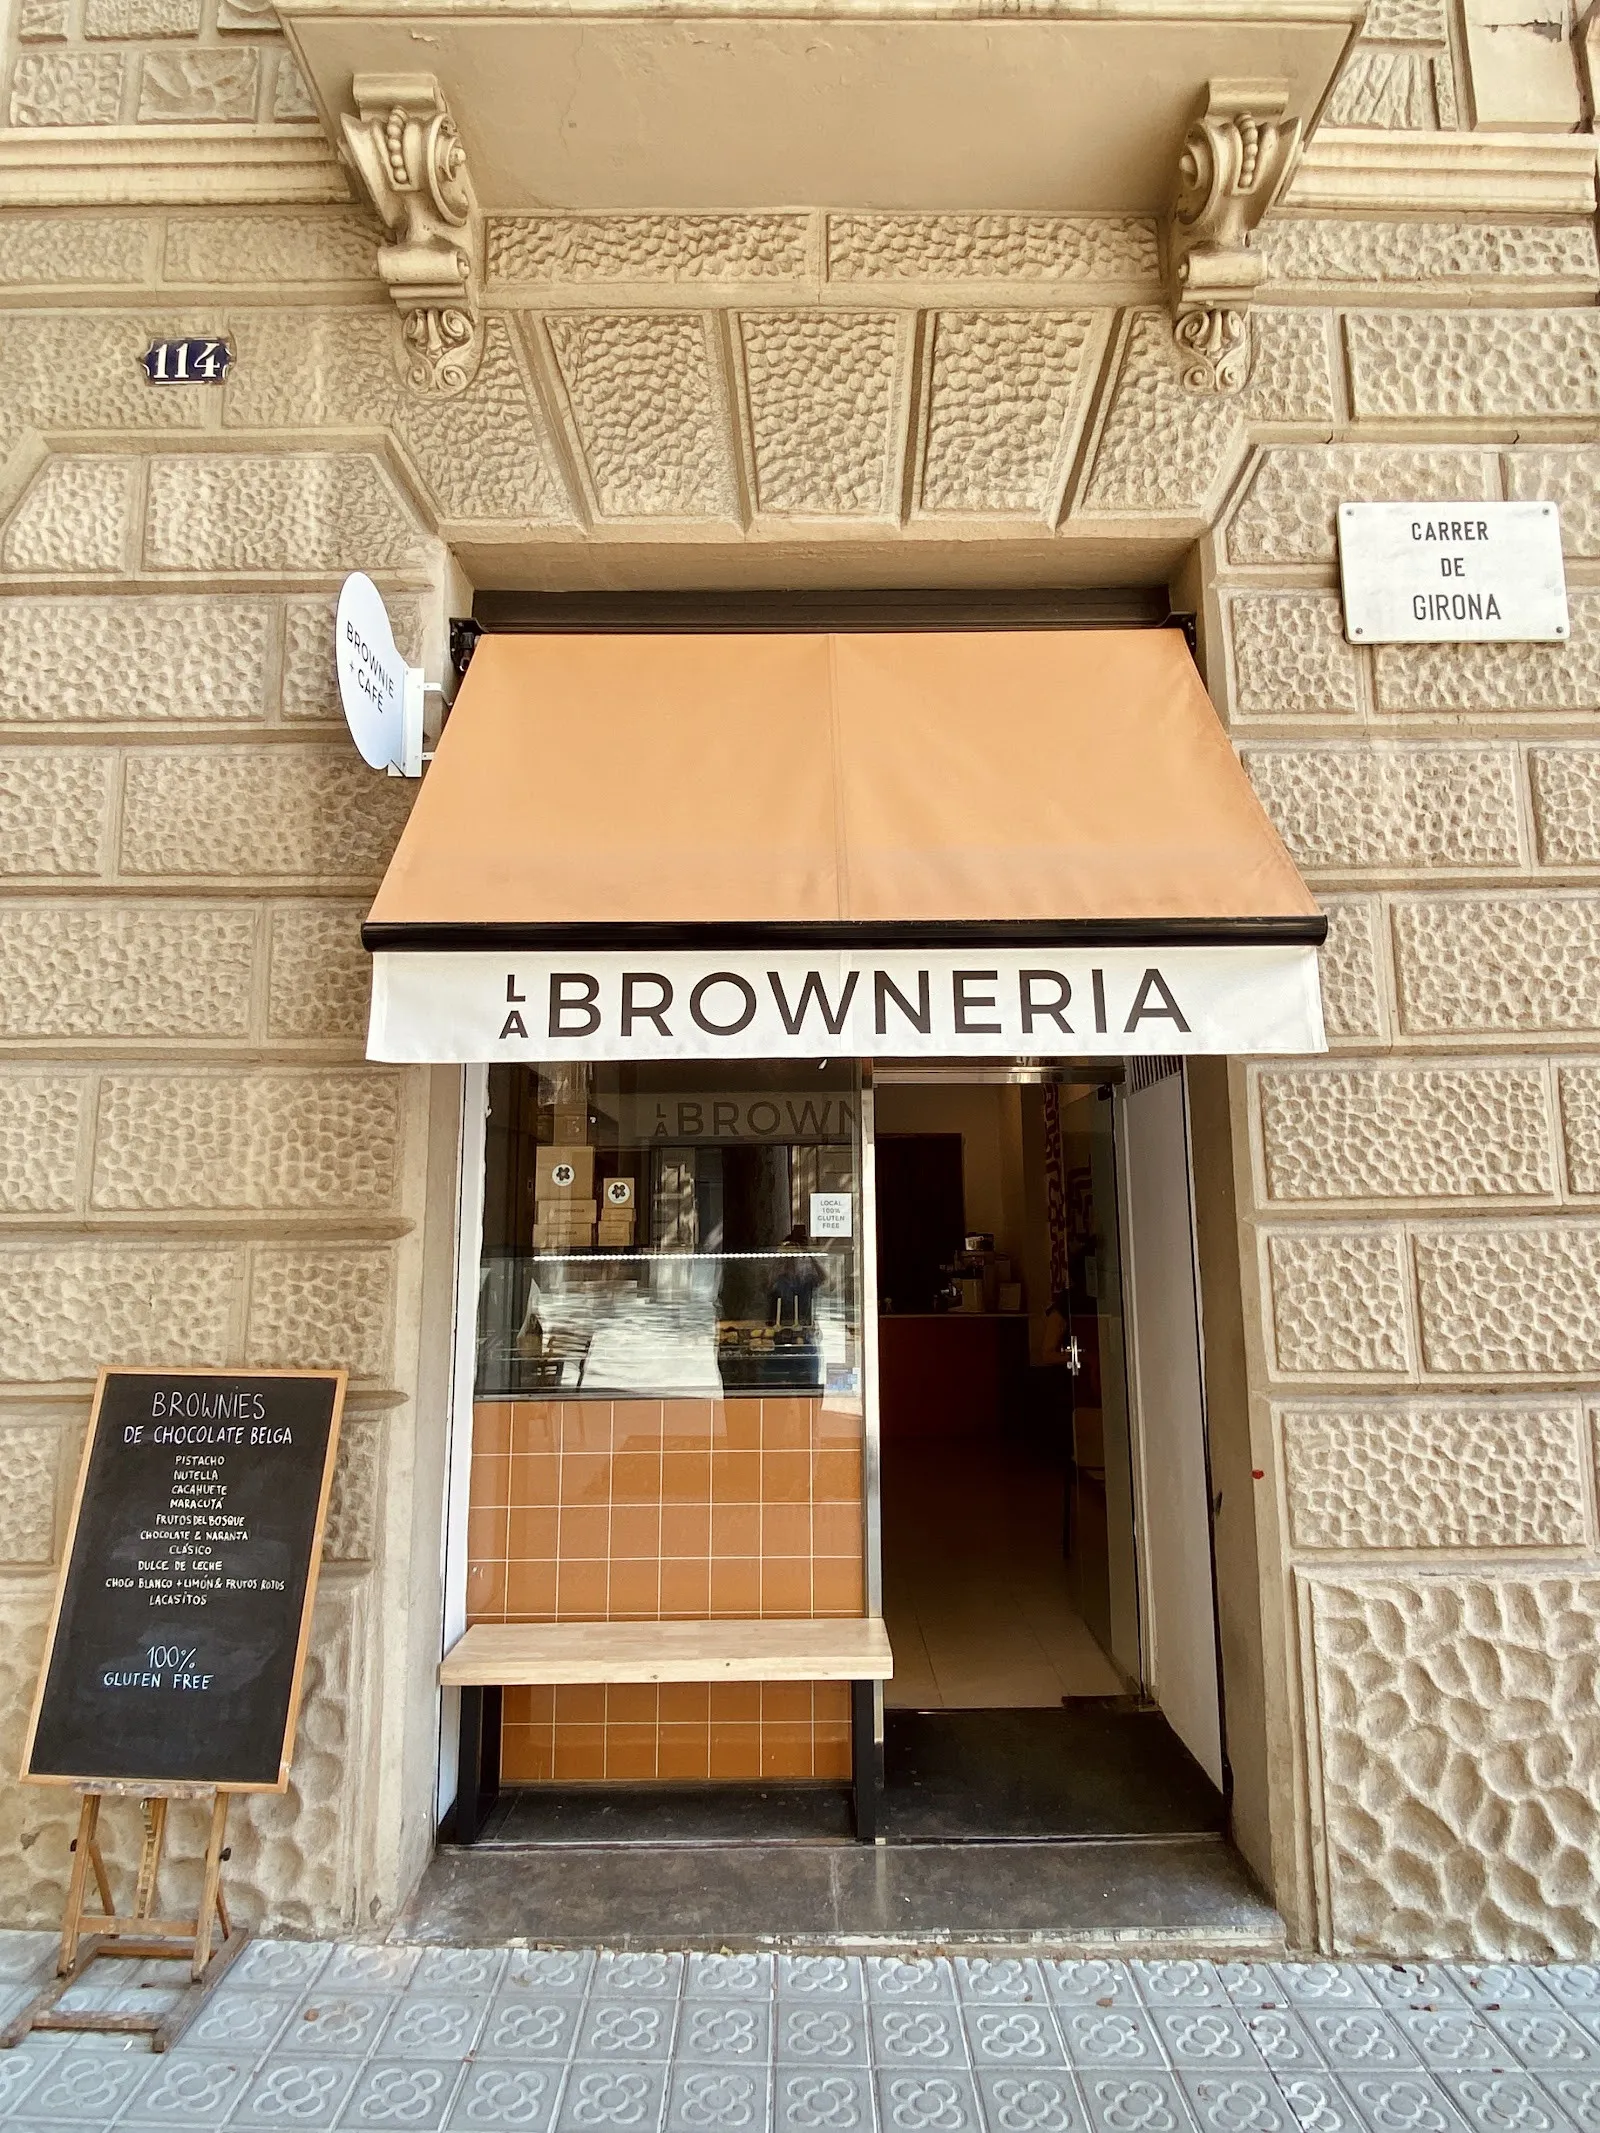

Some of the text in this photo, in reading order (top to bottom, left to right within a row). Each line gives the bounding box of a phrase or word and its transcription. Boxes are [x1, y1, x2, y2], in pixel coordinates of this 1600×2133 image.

[153, 342, 220, 378] 114
[1411, 521, 1489, 541] CARRER
[1441, 557, 1465, 577] DE
[1412, 593, 1502, 621] GIRONA
[346, 620, 394, 700] BROWNIE
[357, 668, 383, 714] CAFÉ
[547, 968, 1192, 1038] BROWNERIA
[151, 1389, 265, 1420] BROWNIES
[124, 1426, 292, 1445] DE CHOCOLATE BELGA
[175, 1455, 225, 1466] PISTACHO
[173, 1470, 219, 1481] NUTELLA
[171, 1484, 228, 1496] CACAHUETE
[156, 1514, 245, 1526] FRUTOS DEL BOSQUE
[140, 1530, 248, 1541] CHOCOLATE & NARANJA
[169, 1543, 212, 1554] CLÁSICO
[138, 1560, 223, 1571] DULCE DE LECHE
[105, 1578, 134, 1588] CHOCO
[138, 1578, 173, 1589] BLANCO
[226, 1579, 257, 1589] FRUTOS
[260, 1579, 285, 1591] ROJOS
[146, 1645, 197, 1672] 100%
[103, 1672, 214, 1690] GLUTEN FREE
